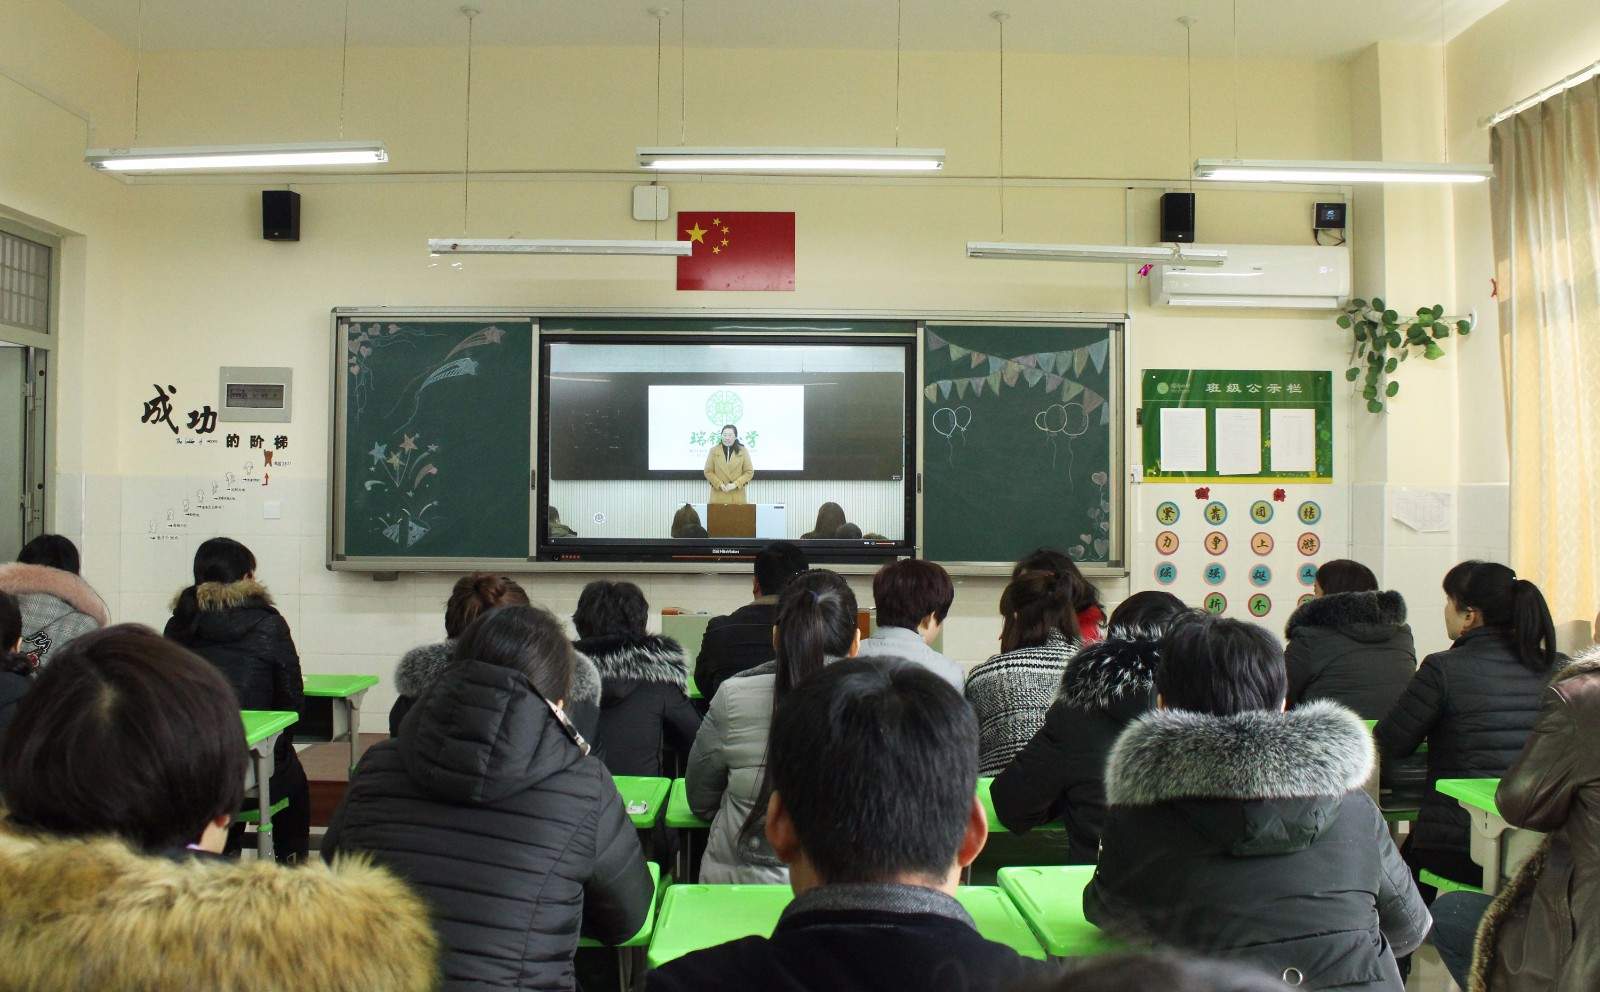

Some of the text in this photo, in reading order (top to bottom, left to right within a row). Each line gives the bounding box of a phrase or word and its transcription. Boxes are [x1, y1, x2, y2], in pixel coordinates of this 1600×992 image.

[1206, 382, 1303, 394] 班级公示栏
[141, 383, 218, 435] 成功
[226, 433, 288, 450] 的阶梯
